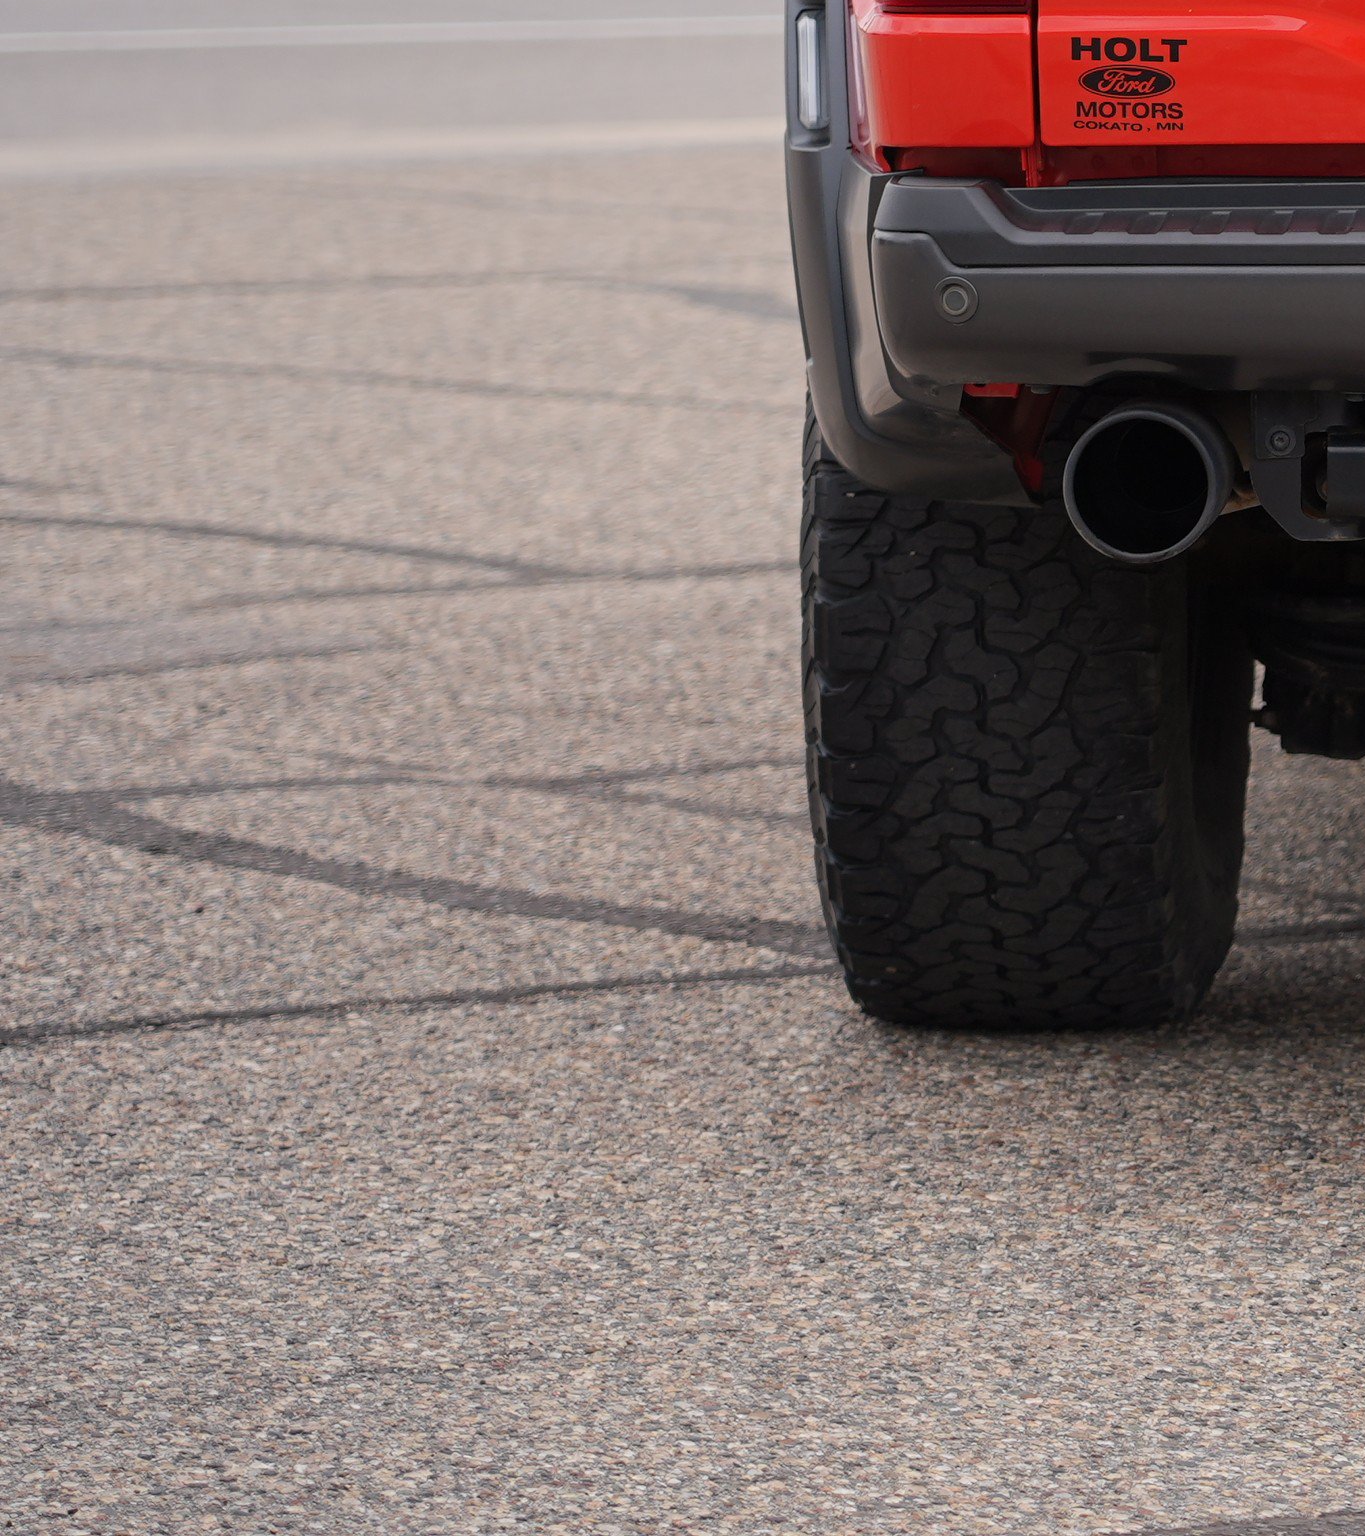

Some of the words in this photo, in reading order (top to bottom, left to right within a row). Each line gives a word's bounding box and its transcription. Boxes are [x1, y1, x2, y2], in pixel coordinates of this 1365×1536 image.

[1071, 37, 1188, 63] HOLT
[1098, 69, 1157, 93] Ford
[1076, 101, 1184, 120] MOTORS
[1156, 122, 1184, 131] MN
